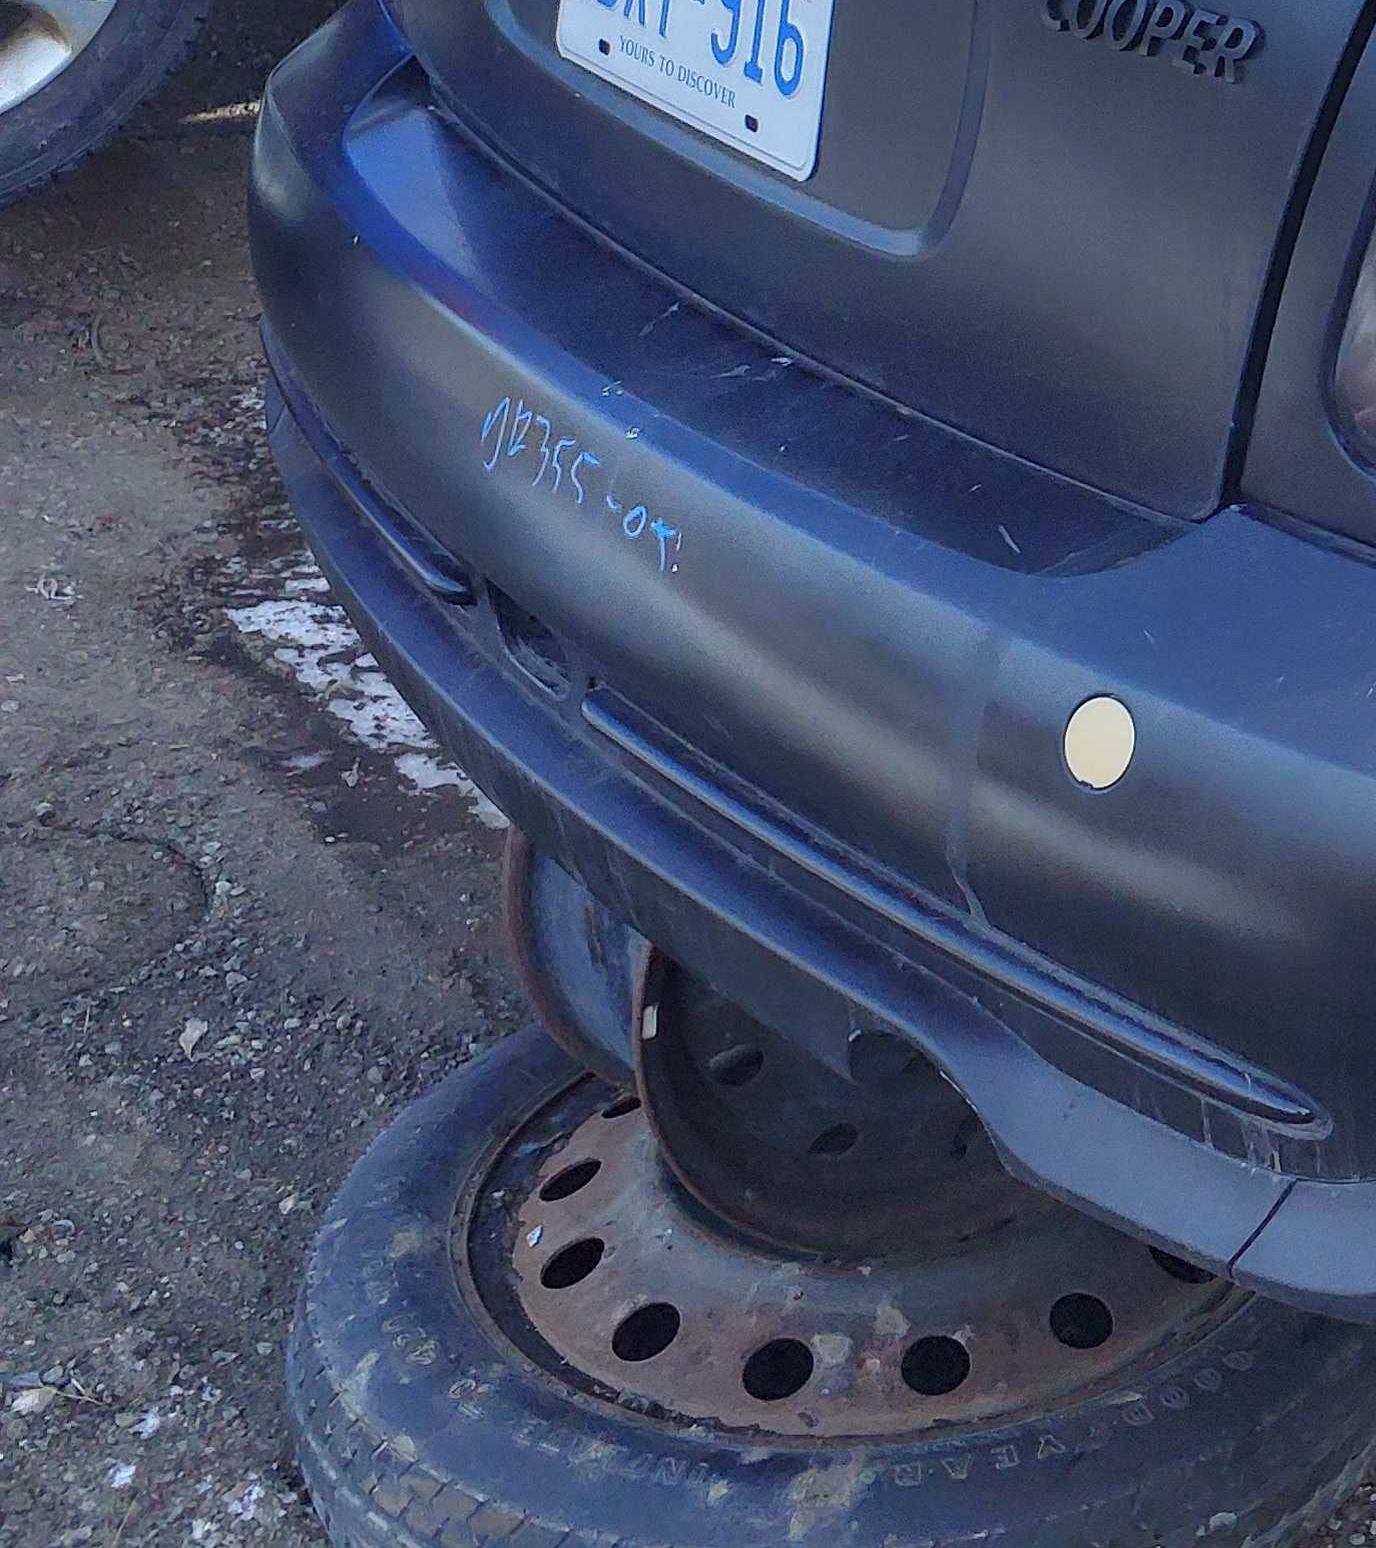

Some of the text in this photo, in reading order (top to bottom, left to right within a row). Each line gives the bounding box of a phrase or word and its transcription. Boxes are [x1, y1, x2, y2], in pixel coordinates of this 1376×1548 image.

[619, 34, 737, 109] YOURS TO DISCOVER
